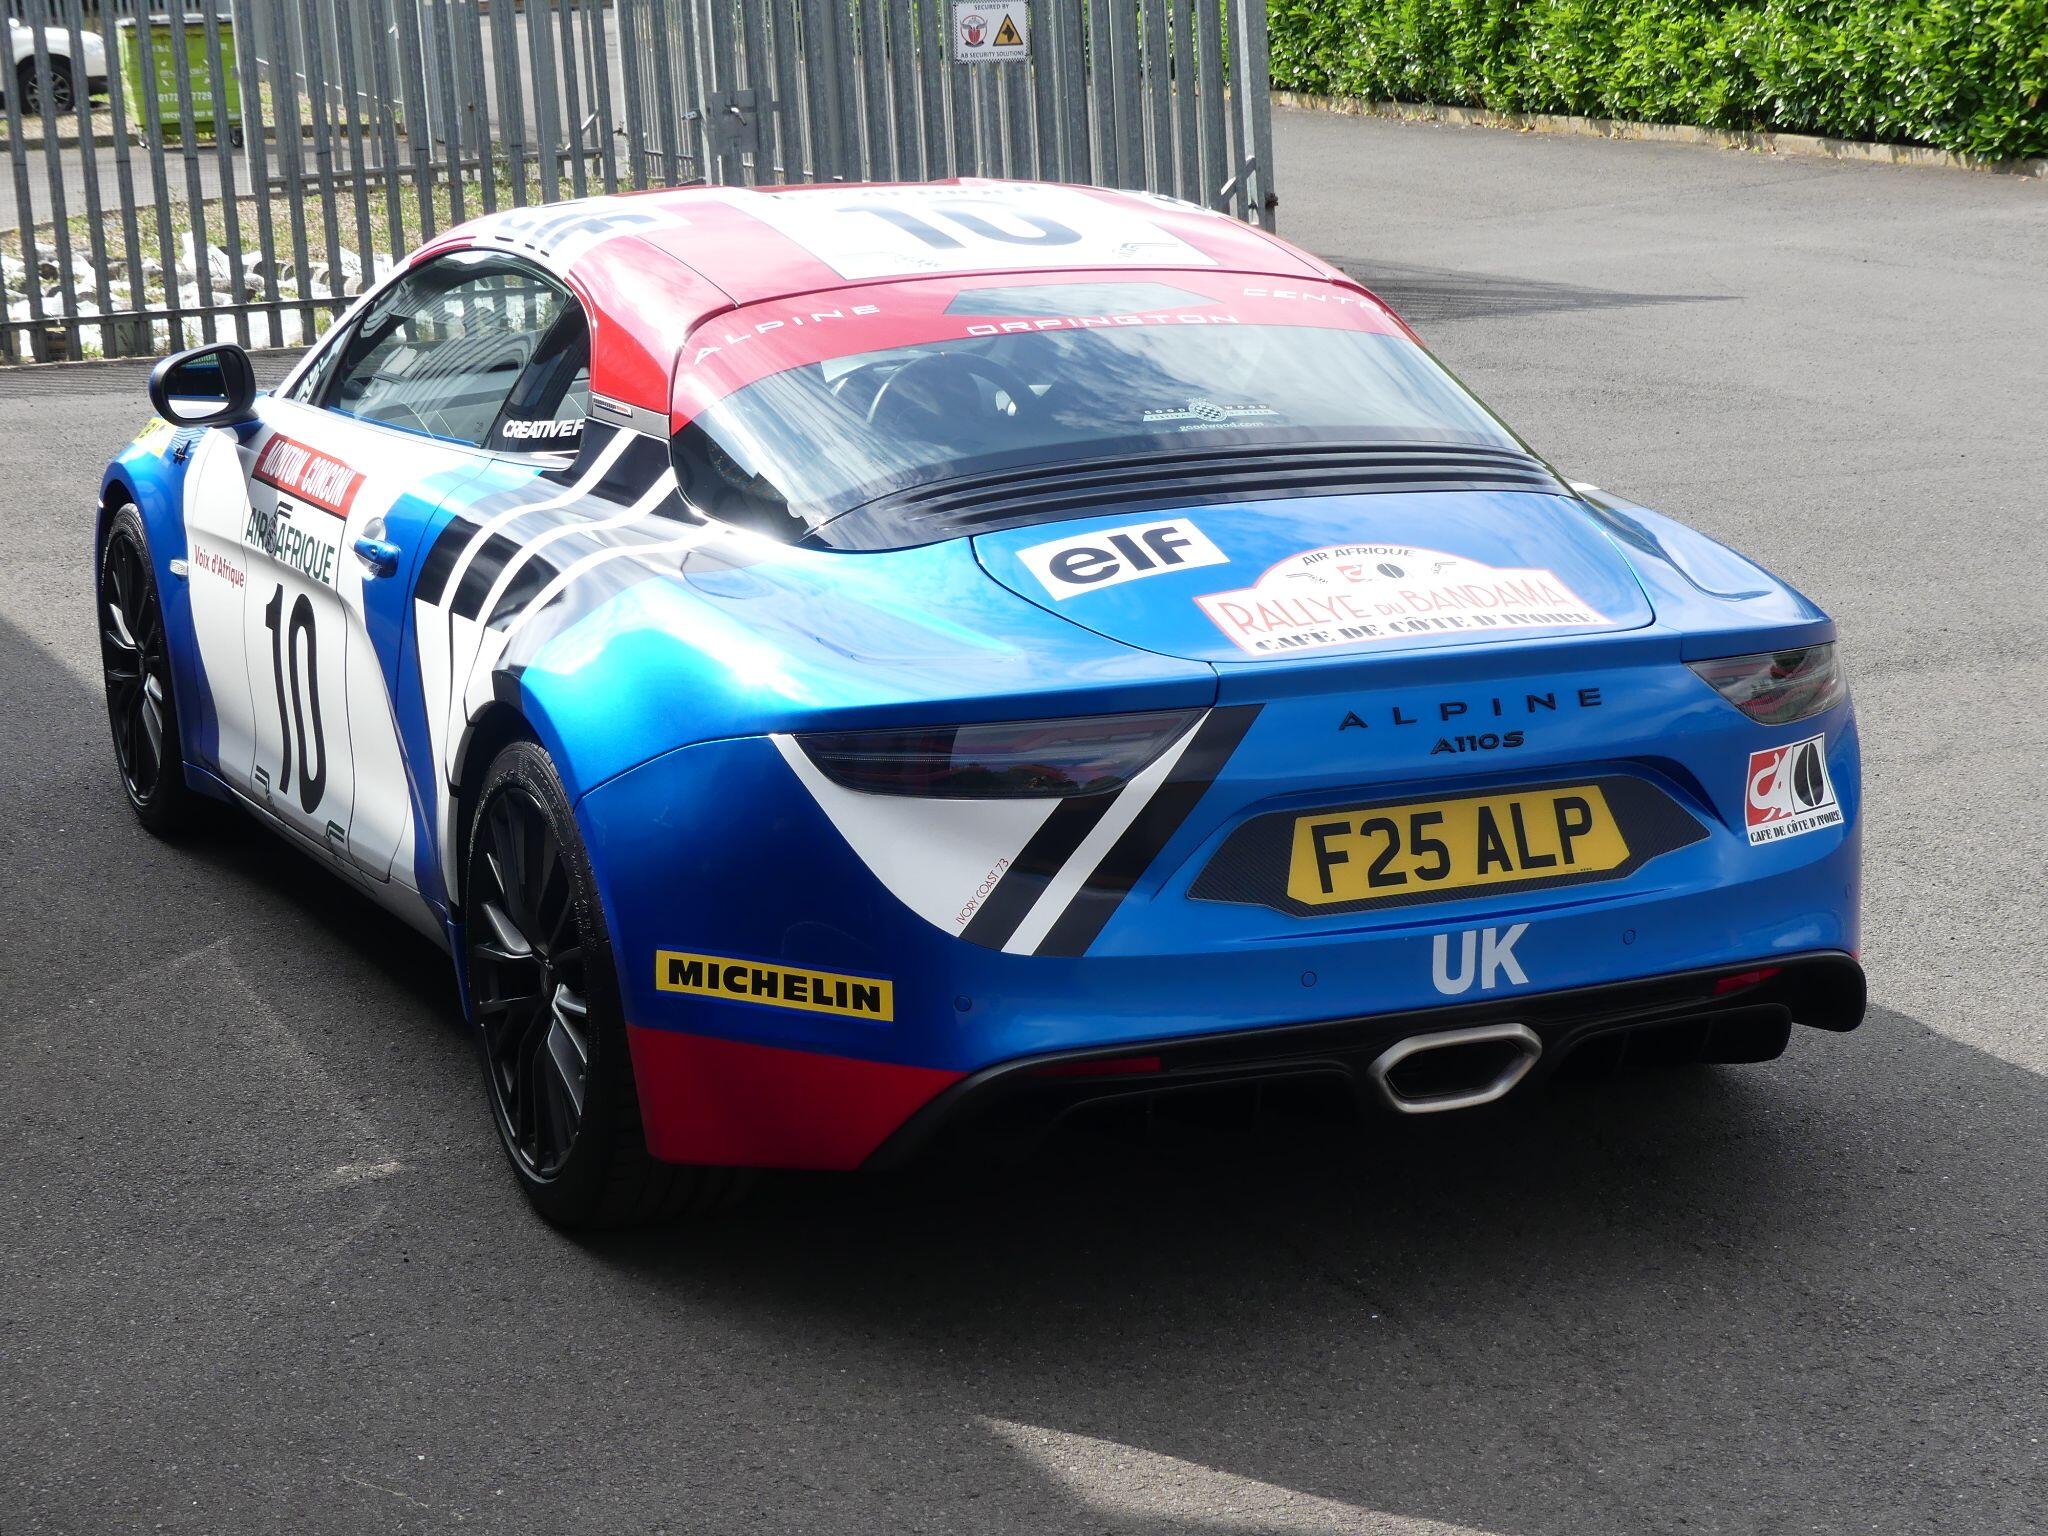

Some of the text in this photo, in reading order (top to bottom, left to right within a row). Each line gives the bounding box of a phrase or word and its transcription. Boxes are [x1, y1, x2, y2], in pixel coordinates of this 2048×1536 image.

[834, 199, 1083, 249] 10
[694, 304, 880, 366] ALPINE
[967, 314, 1239, 336] ORPINGTON
[1178, 422, 1264, 432] goodwood.com
[261, 440, 311, 487] MOUTON
[195, 544, 244, 588] Voix d'Afrique
[245, 508, 335, 584] AIR AFRIQUE
[1049, 527, 1192, 584] elf
[1302, 547, 1416, 566] AIR AFRIQUE
[1217, 595, 1372, 635] RALLYE
[1398, 579, 1577, 612] BANDAMA
[1339, 625, 1386, 640] DE
[266, 582, 326, 814] 10
[1339, 687, 1602, 731] ALPINE
[1430, 730, 1525, 755] A110S
[1311, 796, 1593, 893] F25 ALP
[1774, 826, 1785, 838] DE
[1787, 820, 1808, 834] CÔTE
[956, 858, 1009, 925] IVORY COAST 73
[1432, 922, 1531, 994] UK
[668, 958, 881, 1013] MICHELIN
